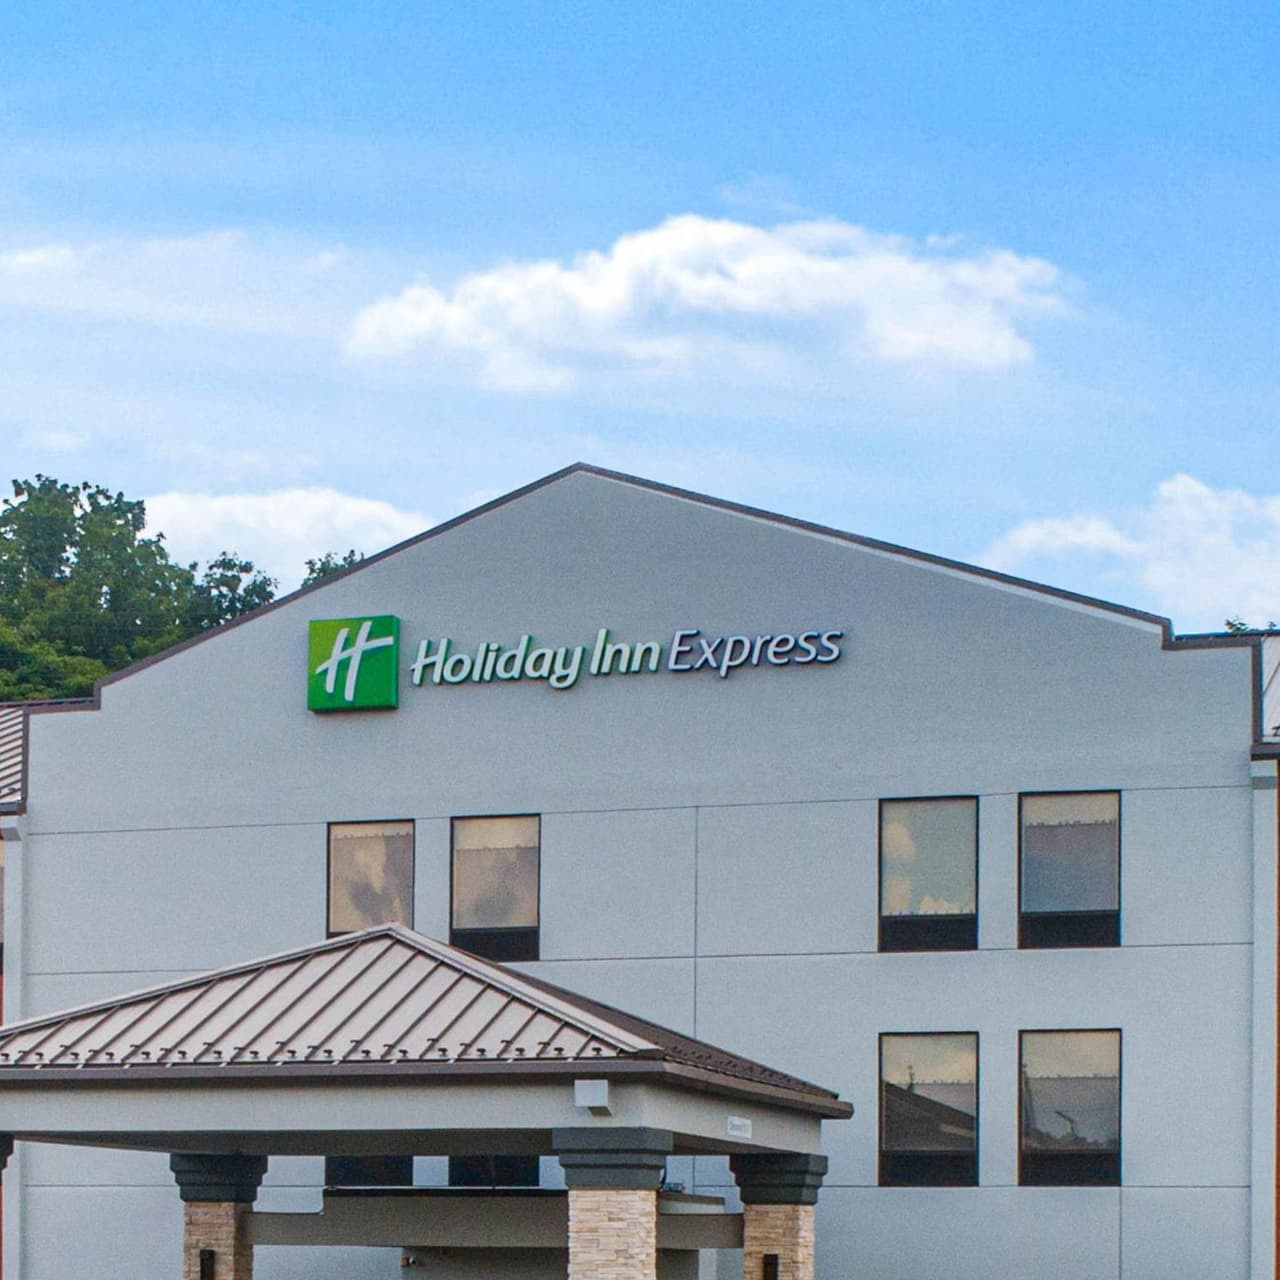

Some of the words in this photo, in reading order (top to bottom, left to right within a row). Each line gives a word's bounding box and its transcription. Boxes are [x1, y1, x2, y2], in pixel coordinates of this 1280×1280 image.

[410, 635, 586, 689] Holiday
[589, 628, 661, 676] Inn
[668, 629, 844, 678] Express
